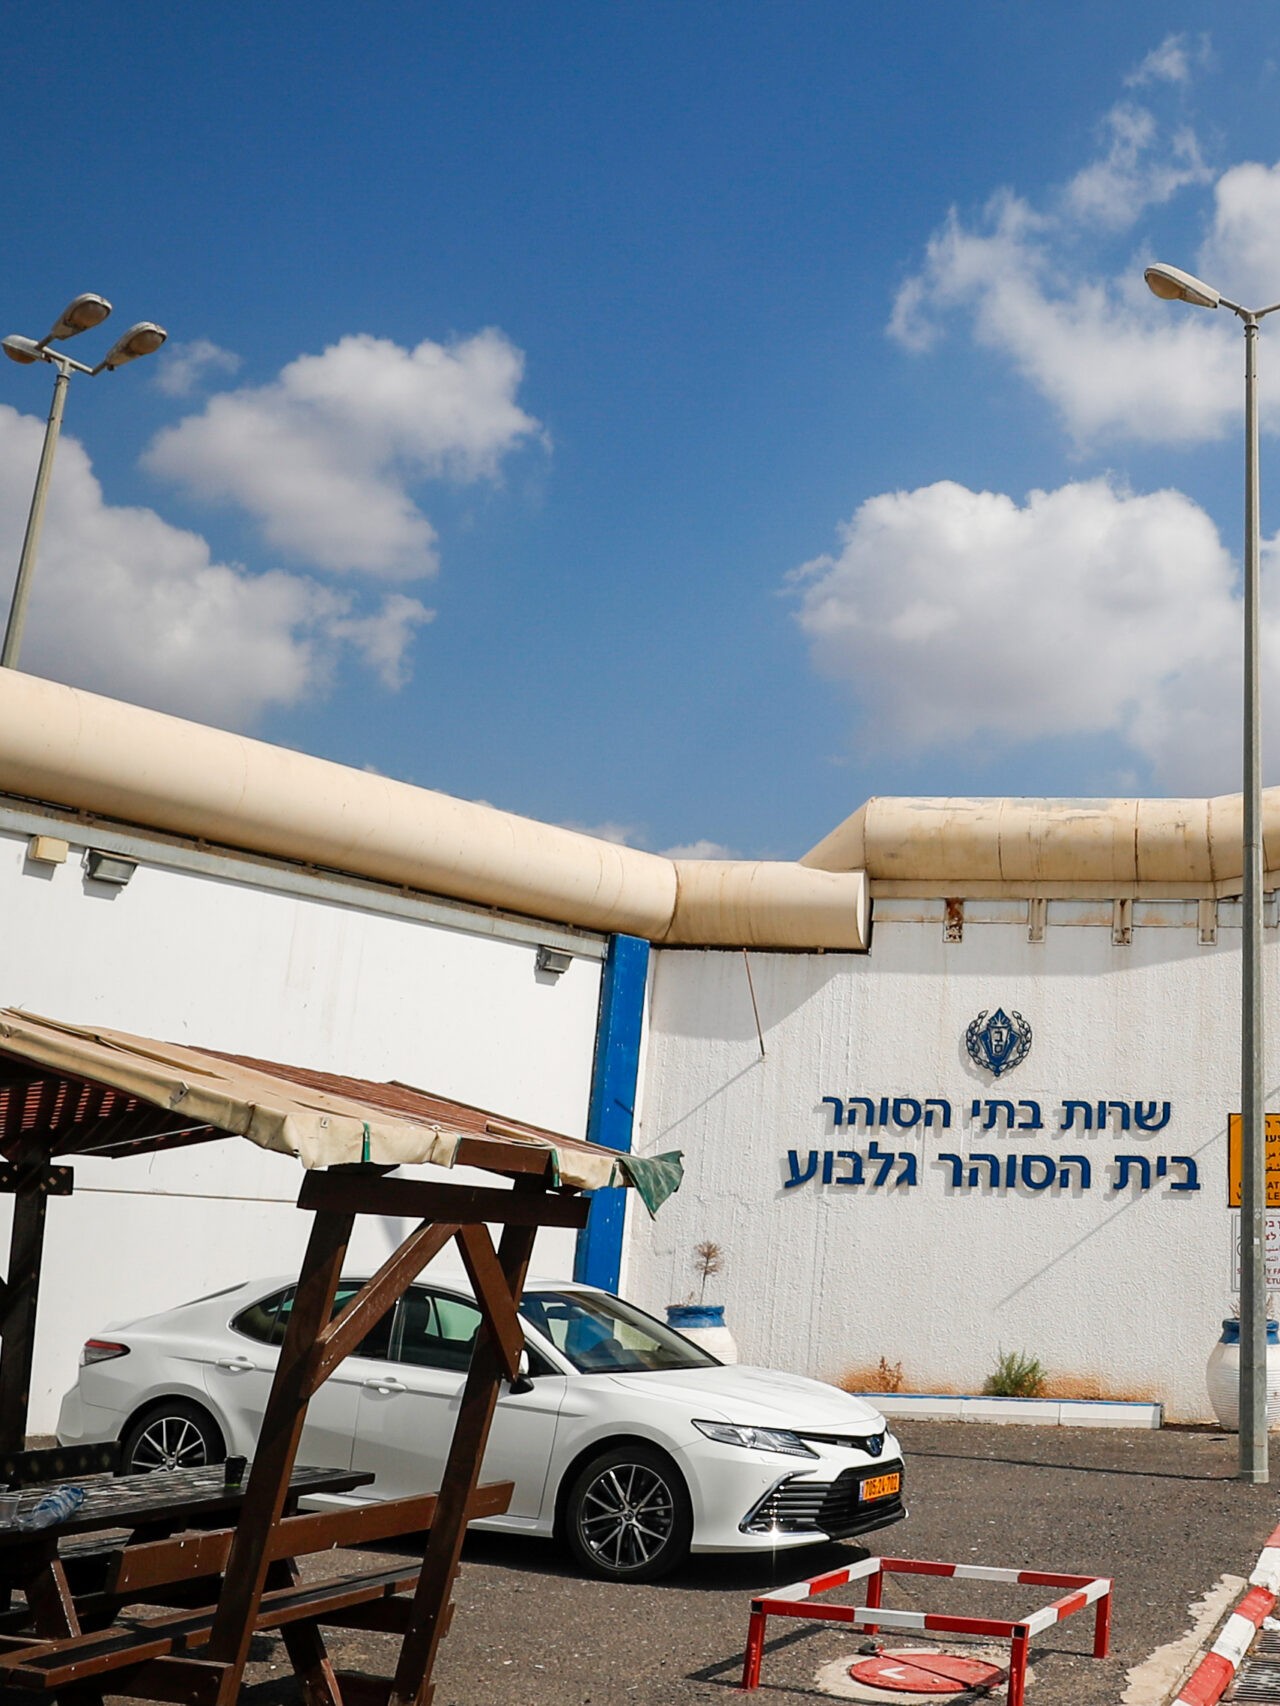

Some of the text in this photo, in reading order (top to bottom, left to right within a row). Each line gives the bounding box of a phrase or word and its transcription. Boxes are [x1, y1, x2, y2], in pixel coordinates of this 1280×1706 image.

[823, 1098, 1170, 1130] שרות בתי הסוהר
[785, 1142, 1200, 1189] בית הסוהר גלבוע
